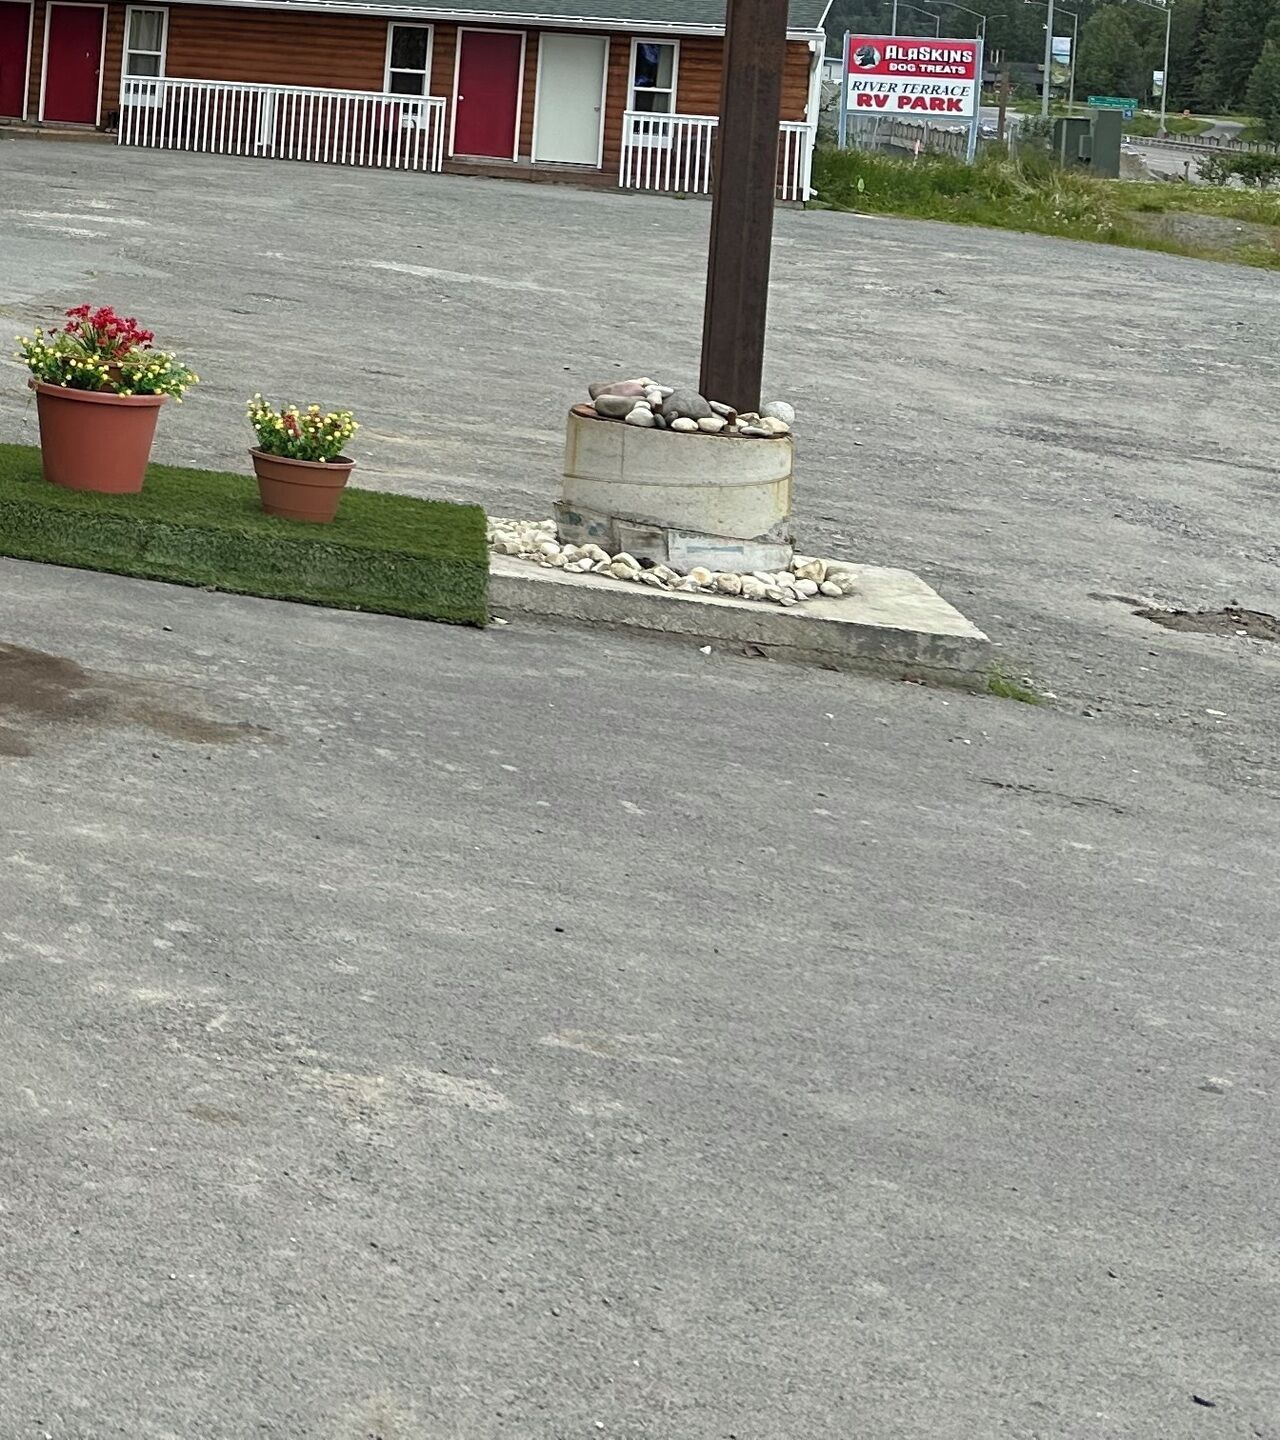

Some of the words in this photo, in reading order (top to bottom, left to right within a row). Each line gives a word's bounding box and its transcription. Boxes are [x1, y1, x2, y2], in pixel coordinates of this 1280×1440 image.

[888, 63, 916, 72] DOG
[919, 64, 966, 75] TREATS
[851, 80, 898, 94] RIVER
[902, 83, 971, 97] TERRACE
[856, 93, 890, 108] RV
[897, 95, 964, 112] PARK
